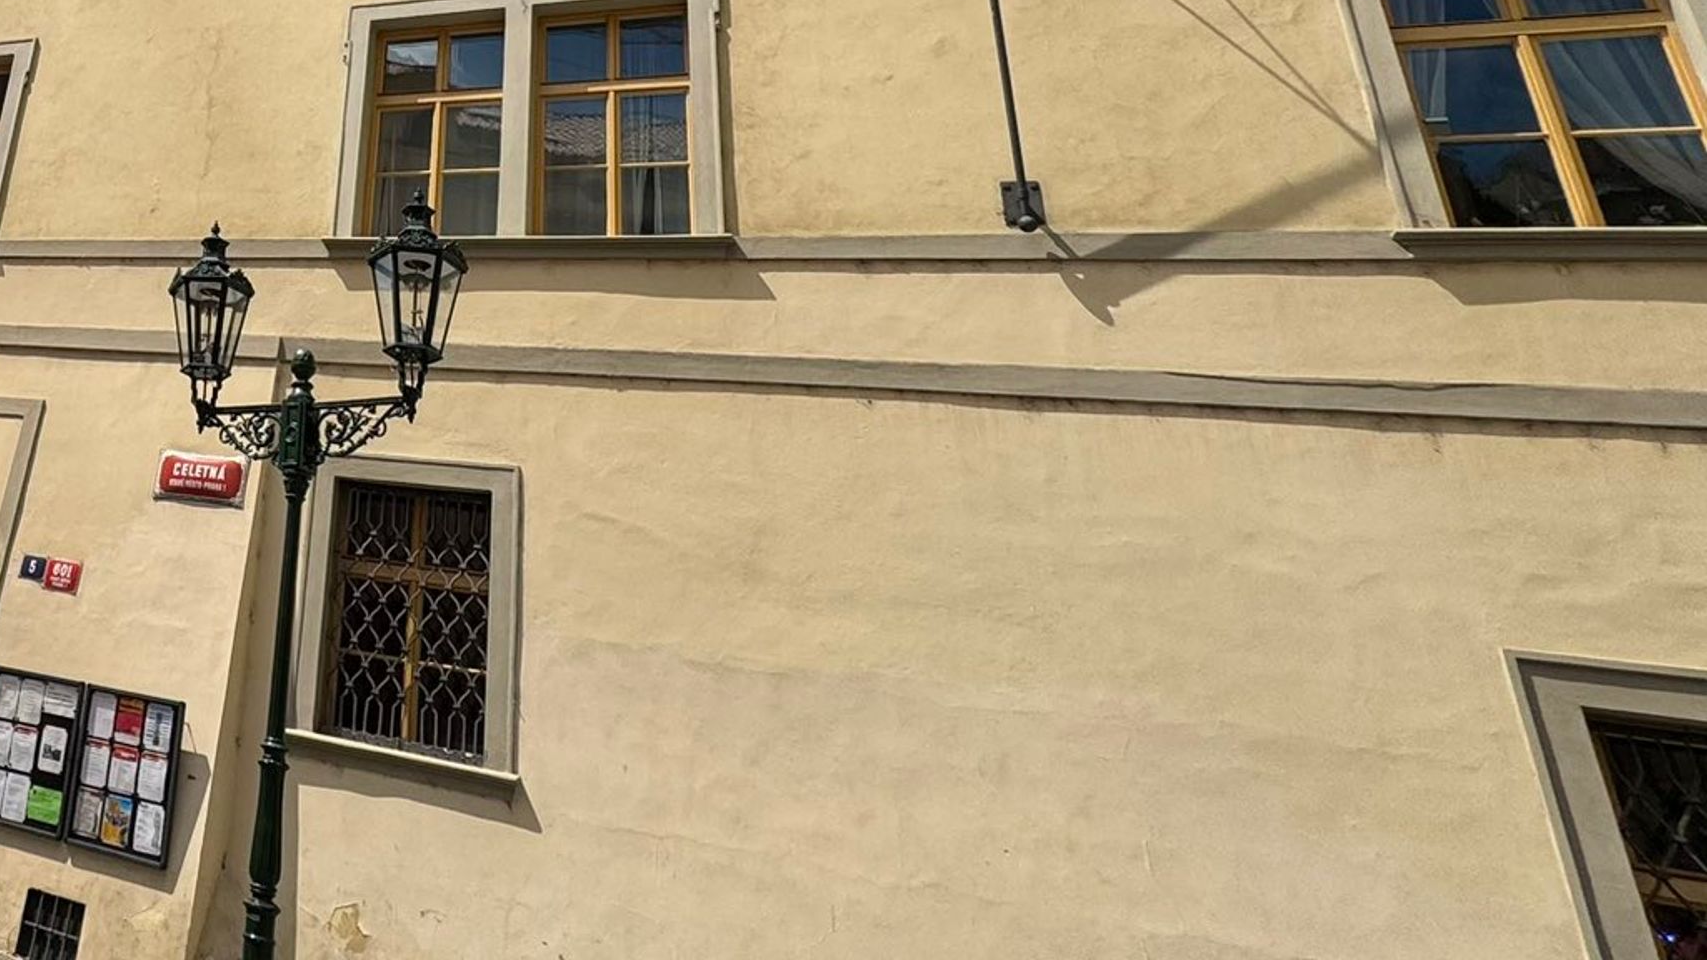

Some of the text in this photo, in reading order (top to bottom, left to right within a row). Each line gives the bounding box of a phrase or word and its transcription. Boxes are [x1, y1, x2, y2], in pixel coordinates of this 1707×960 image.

[172, 461, 227, 480] CELETNÁ
[28, 559, 37, 574] 5
[52, 562, 73, 578] 601
